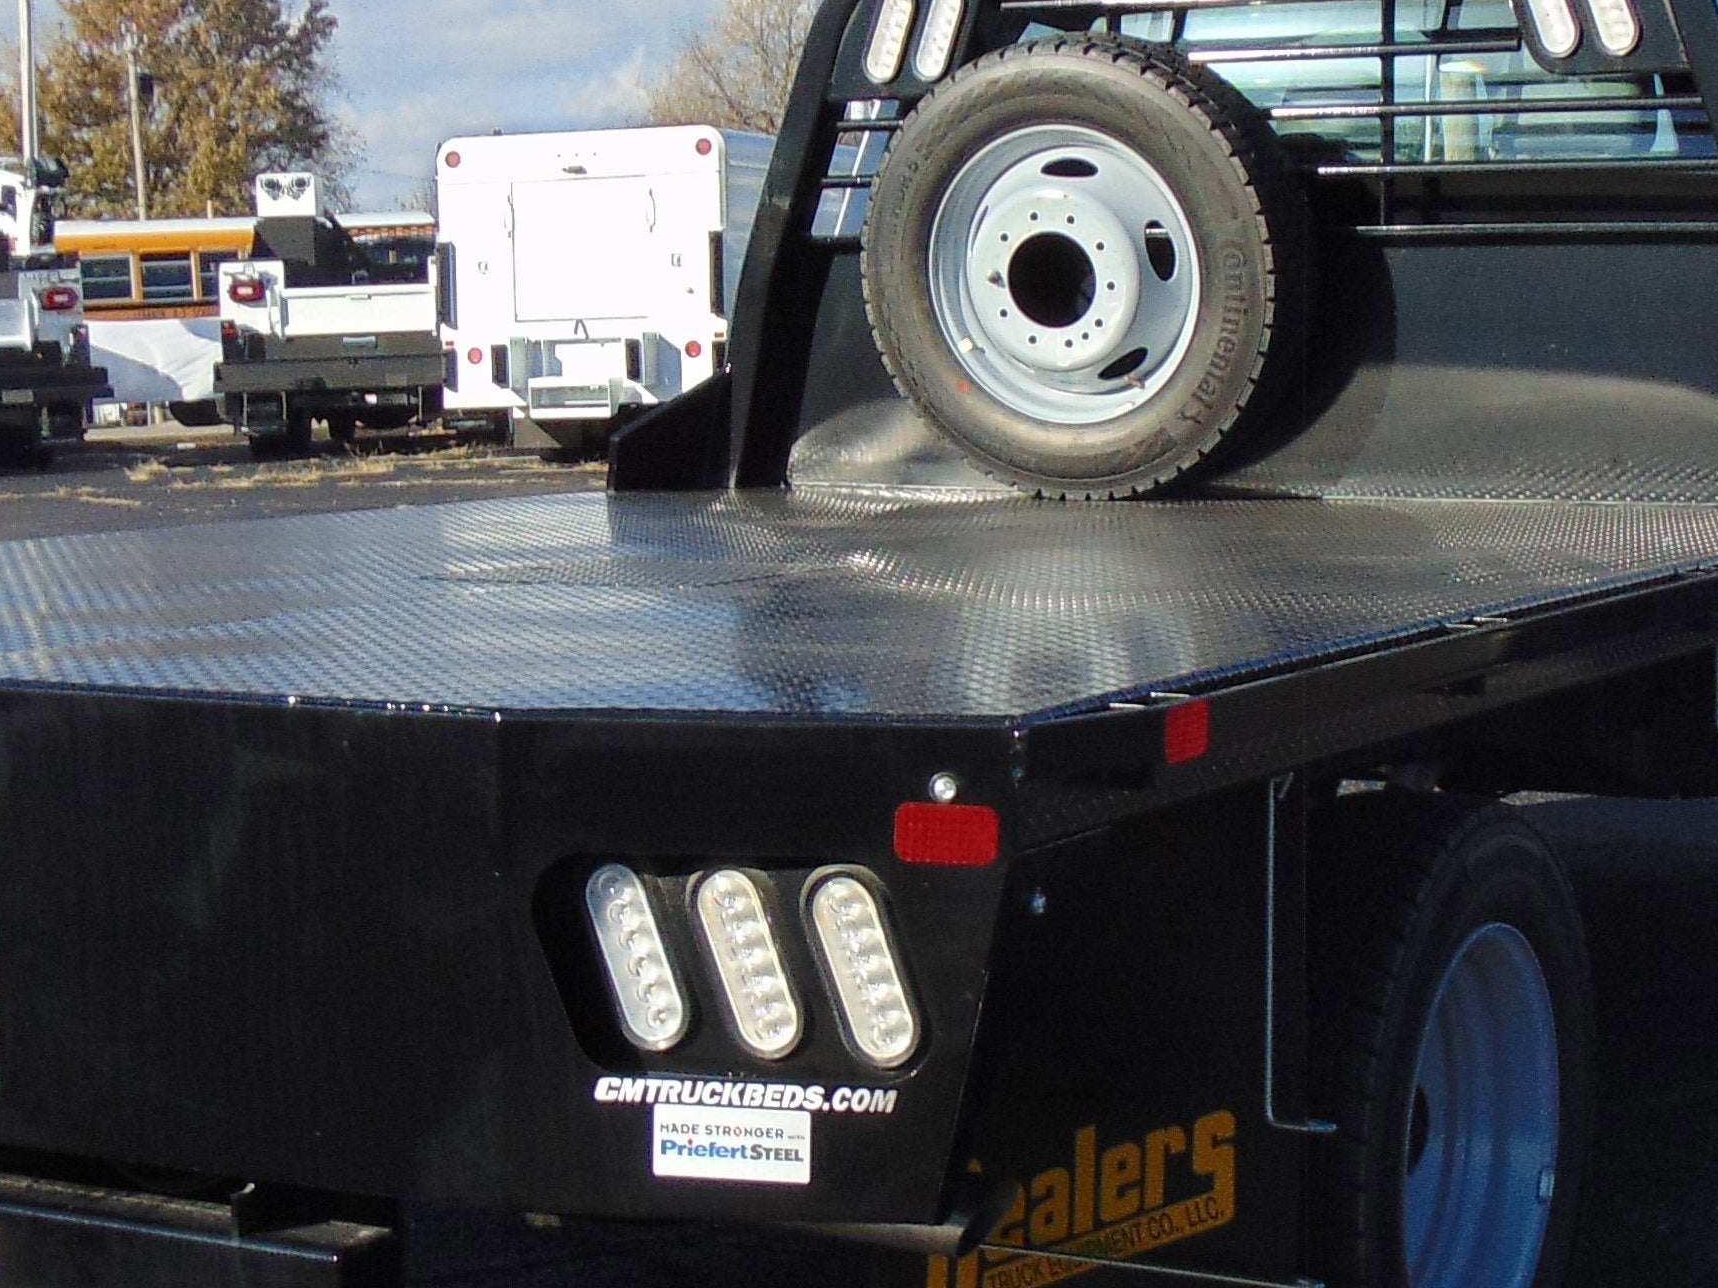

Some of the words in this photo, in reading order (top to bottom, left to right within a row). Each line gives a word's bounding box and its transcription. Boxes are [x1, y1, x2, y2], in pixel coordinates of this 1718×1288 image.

[593, 1076, 899, 1114] CMTRUCKBEDS.COM
[660, 1123, 700, 1135] MADE
[704, 1125, 784, 1140] STRONGER
